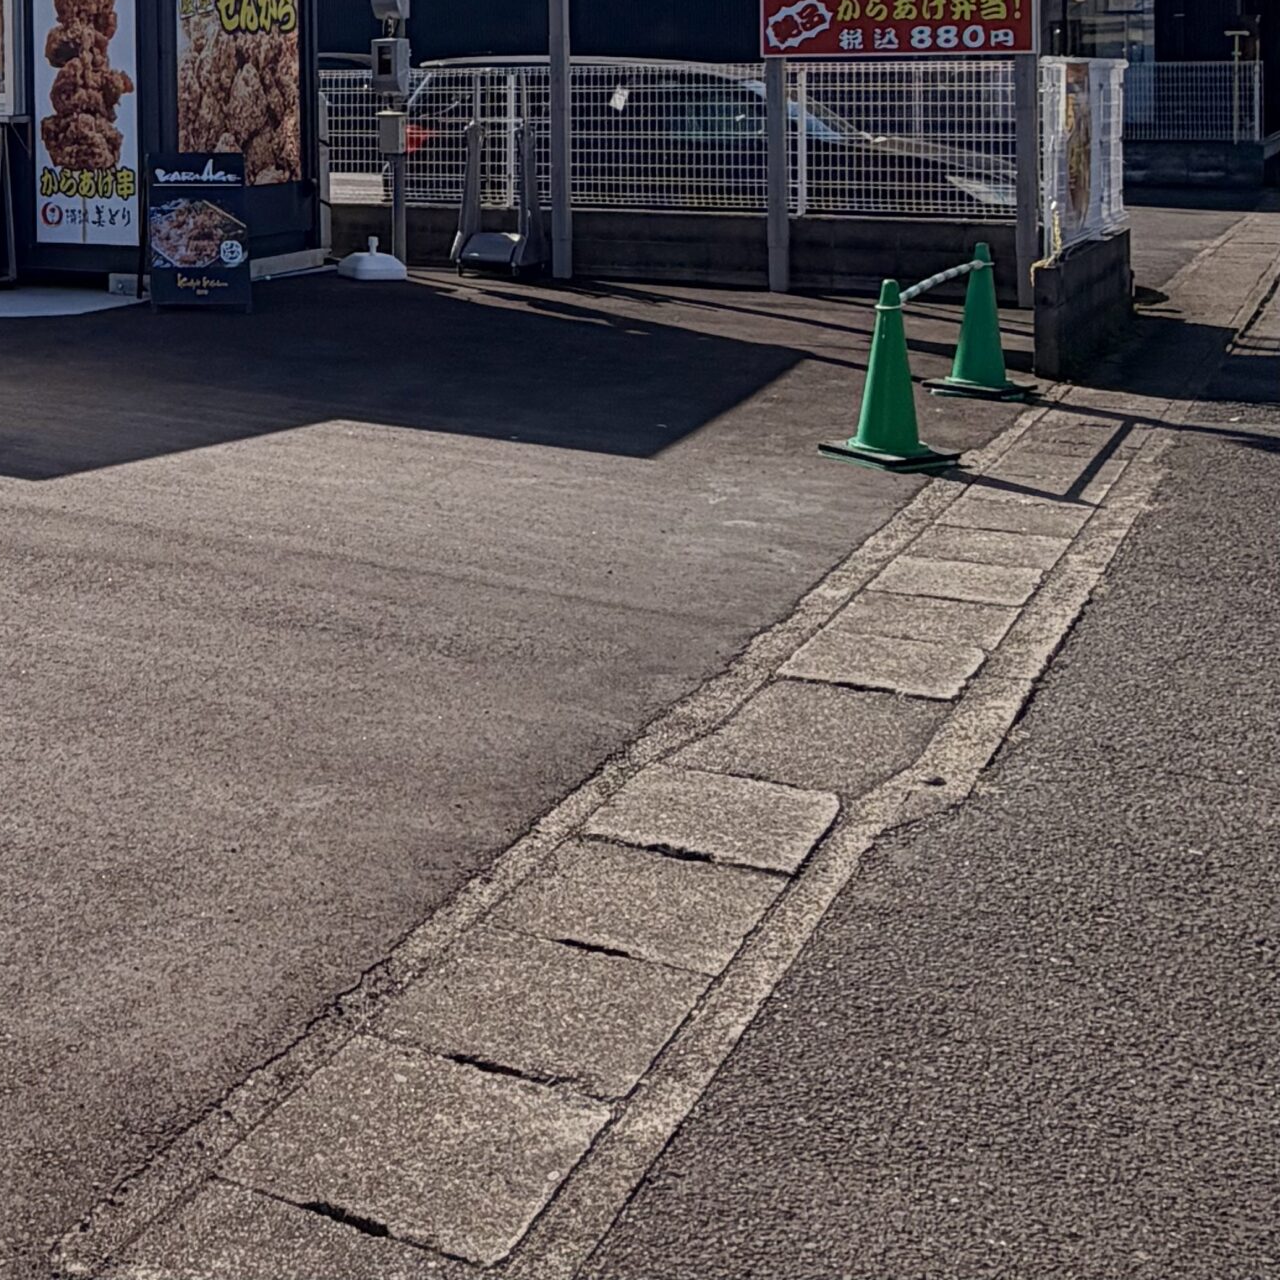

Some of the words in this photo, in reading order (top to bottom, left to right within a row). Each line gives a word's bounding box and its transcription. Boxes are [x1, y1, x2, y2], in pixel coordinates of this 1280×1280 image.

[910, 25, 1015, 50] 880円
[41, 166, 136, 201] からあげ串
